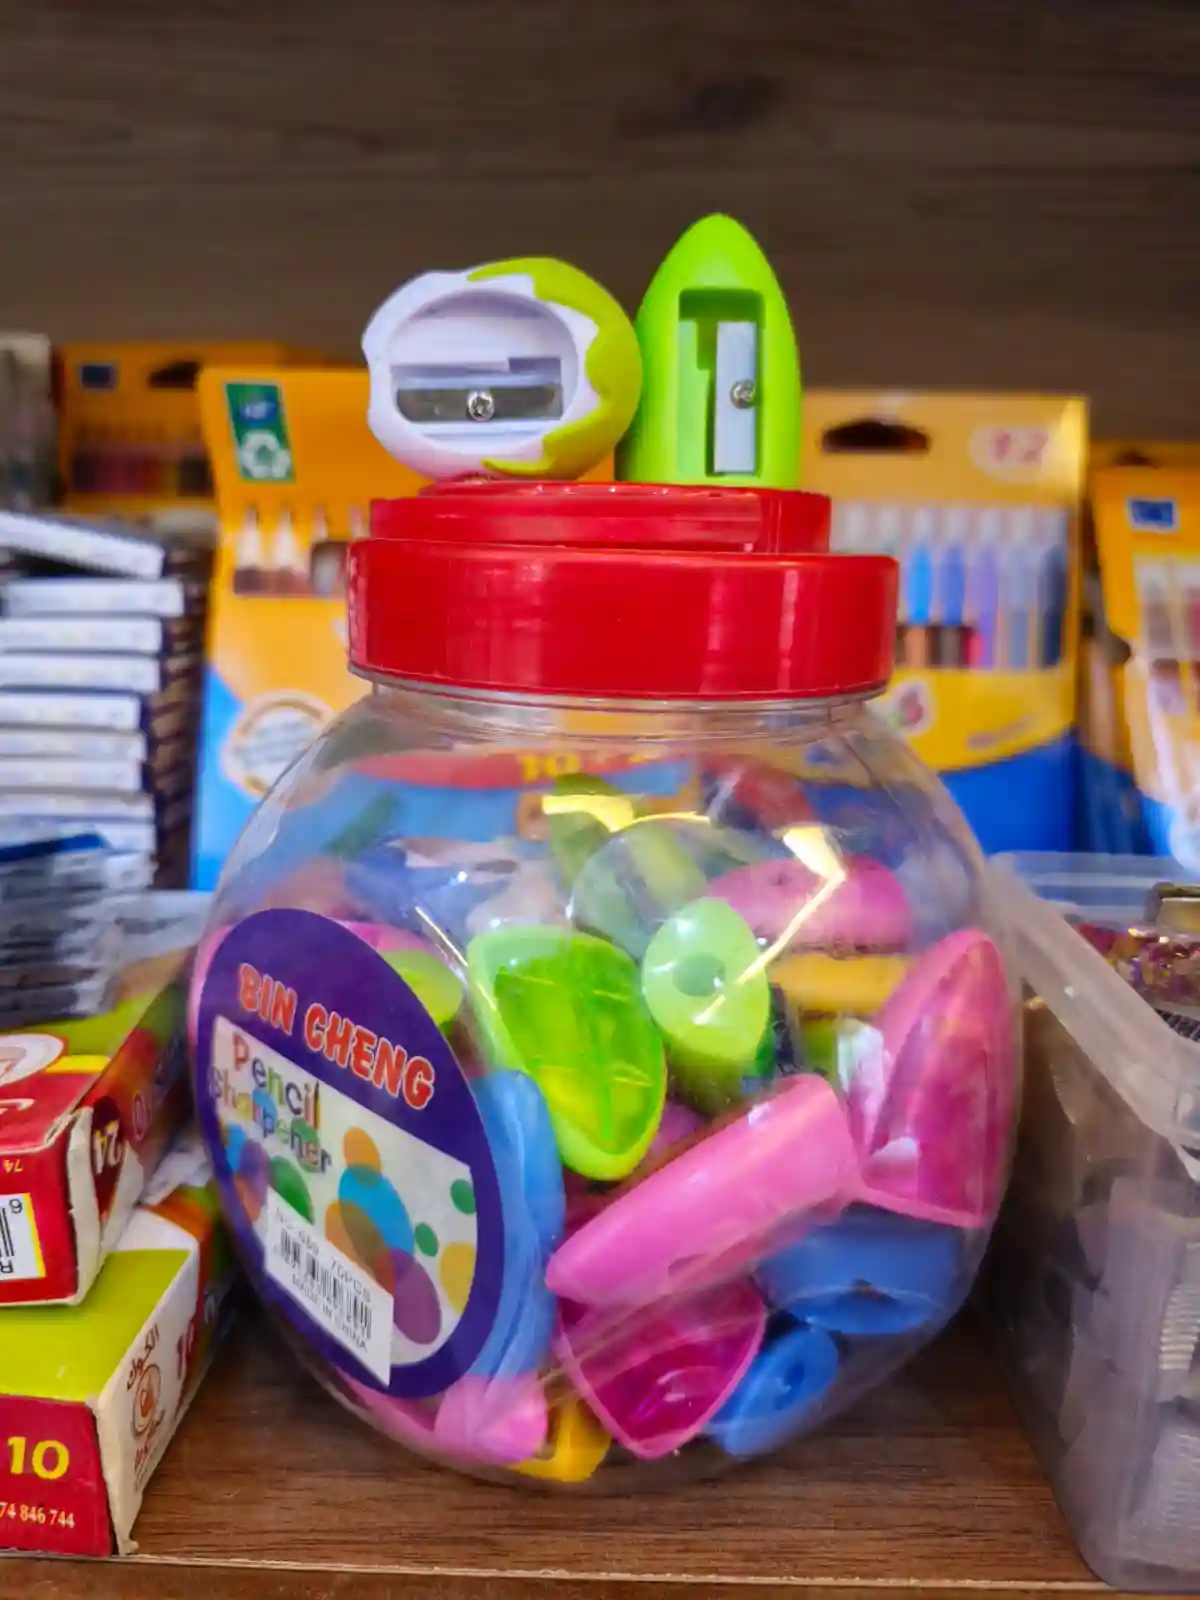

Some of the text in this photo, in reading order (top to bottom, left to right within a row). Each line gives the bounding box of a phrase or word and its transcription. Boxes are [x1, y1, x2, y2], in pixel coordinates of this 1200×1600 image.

[238, 962, 435, 1110] BIN CHENG
[8, 1436, 70, 1480] 10
[20, 1504, 46, 1524] 846
[49, 1508, 76, 1529] 744
